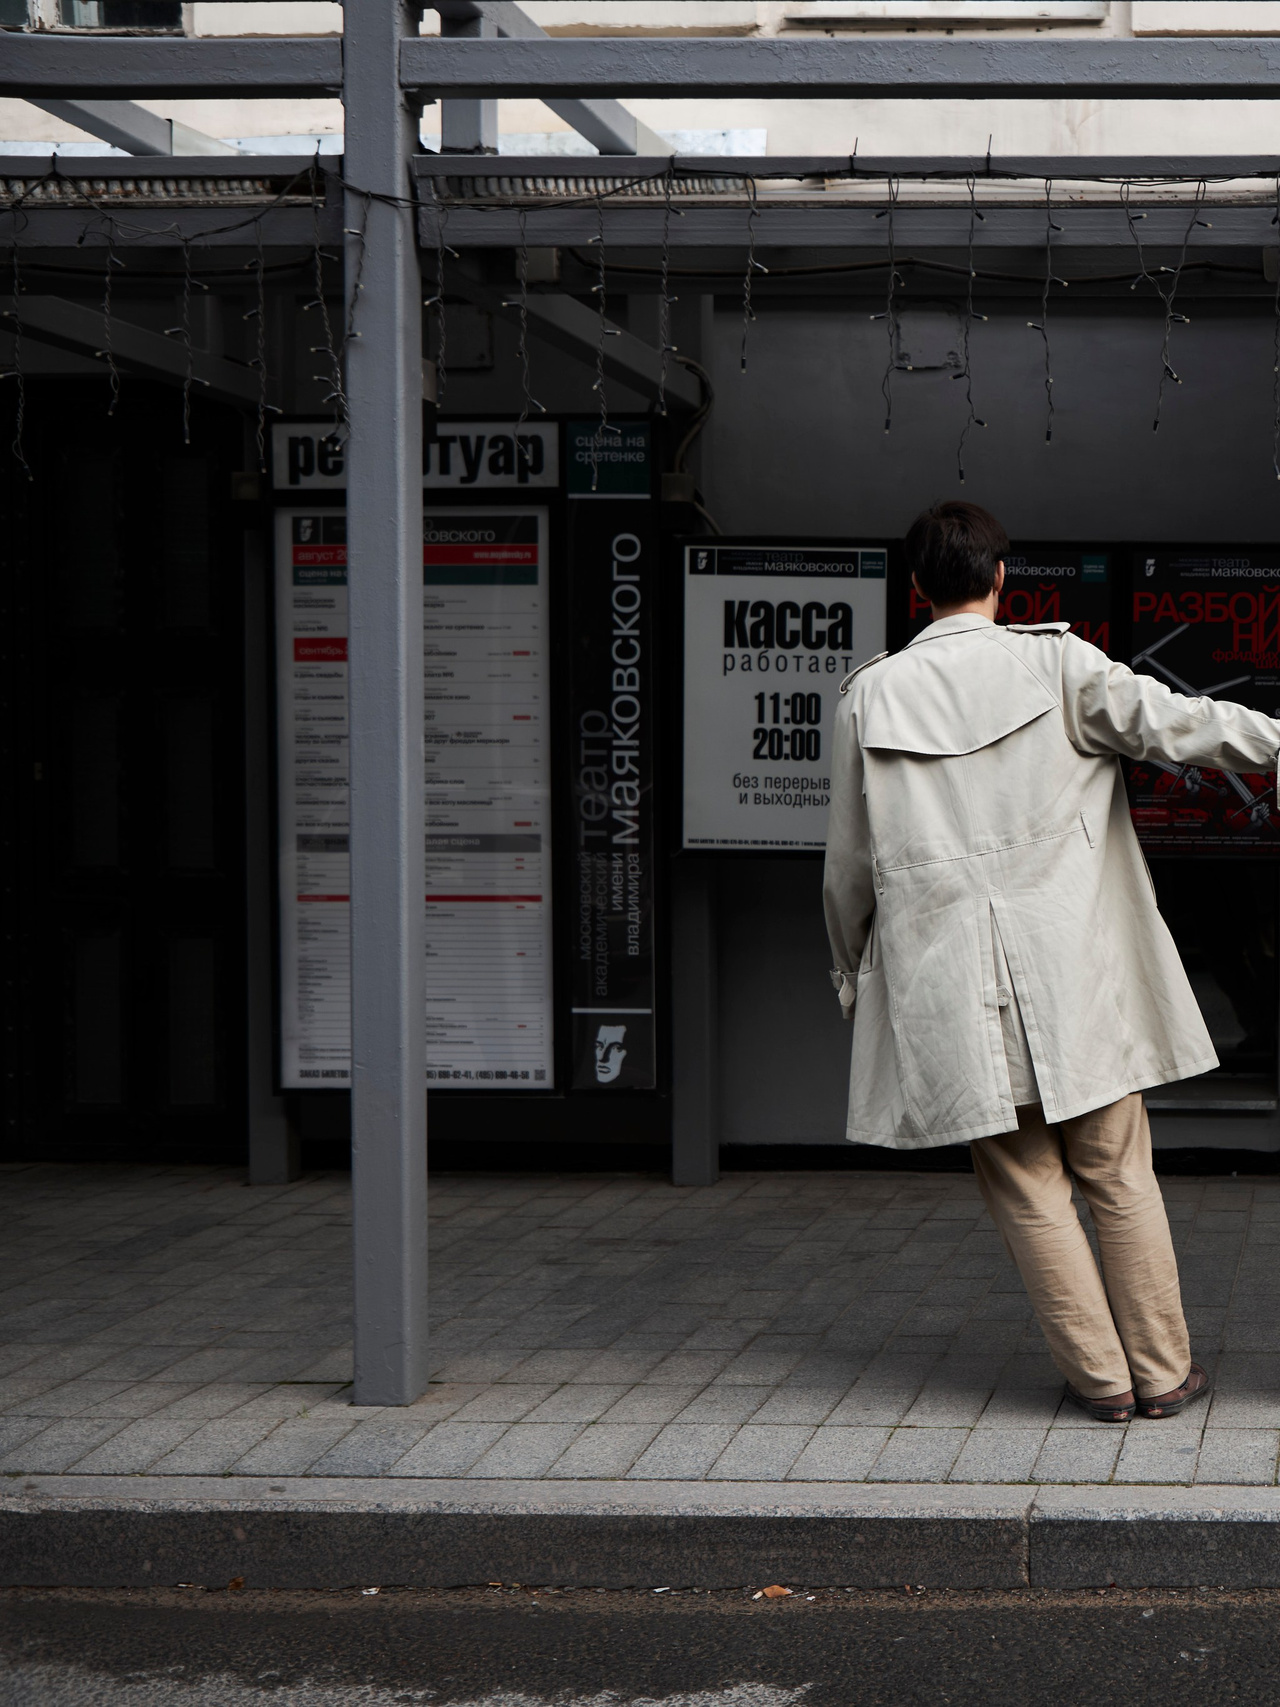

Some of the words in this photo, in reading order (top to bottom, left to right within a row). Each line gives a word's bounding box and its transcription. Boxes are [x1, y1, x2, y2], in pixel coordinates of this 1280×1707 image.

[576, 436, 622, 450] сцена
[626, 436, 645, 447] на
[289, 435, 544, 484] ретуар
[575, 451, 646, 465] сретенке
[423, 530, 496, 543] ковского
[298, 551, 335, 564] август
[1211, 558, 1250, 569] театр
[298, 570, 329, 579] сцена
[330, 570, 342, 578] на
[764, 561, 854, 573] маяковского
[1004, 565, 1076, 577] яковского
[724, 600, 853, 651] касса
[298, 646, 344, 656] сентябрь
[1212, 648, 1280, 664] фридрих
[724, 650, 853, 676] работает
[612, 533, 642, 844] маяковского
[754, 692, 821, 725] 11:00
[753, 728, 820, 761] 20:00
[580, 709, 615, 846] театр
[733, 773, 759, 789] без
[765, 777, 831, 793] перерыв
[739, 792, 749, 805] и
[424, 838, 449, 846] алая
[612, 853, 624, 911] имени
[577, 852, 591, 960] московский
[628, 853, 644, 957] владимира
[593, 852, 611, 997] академический
